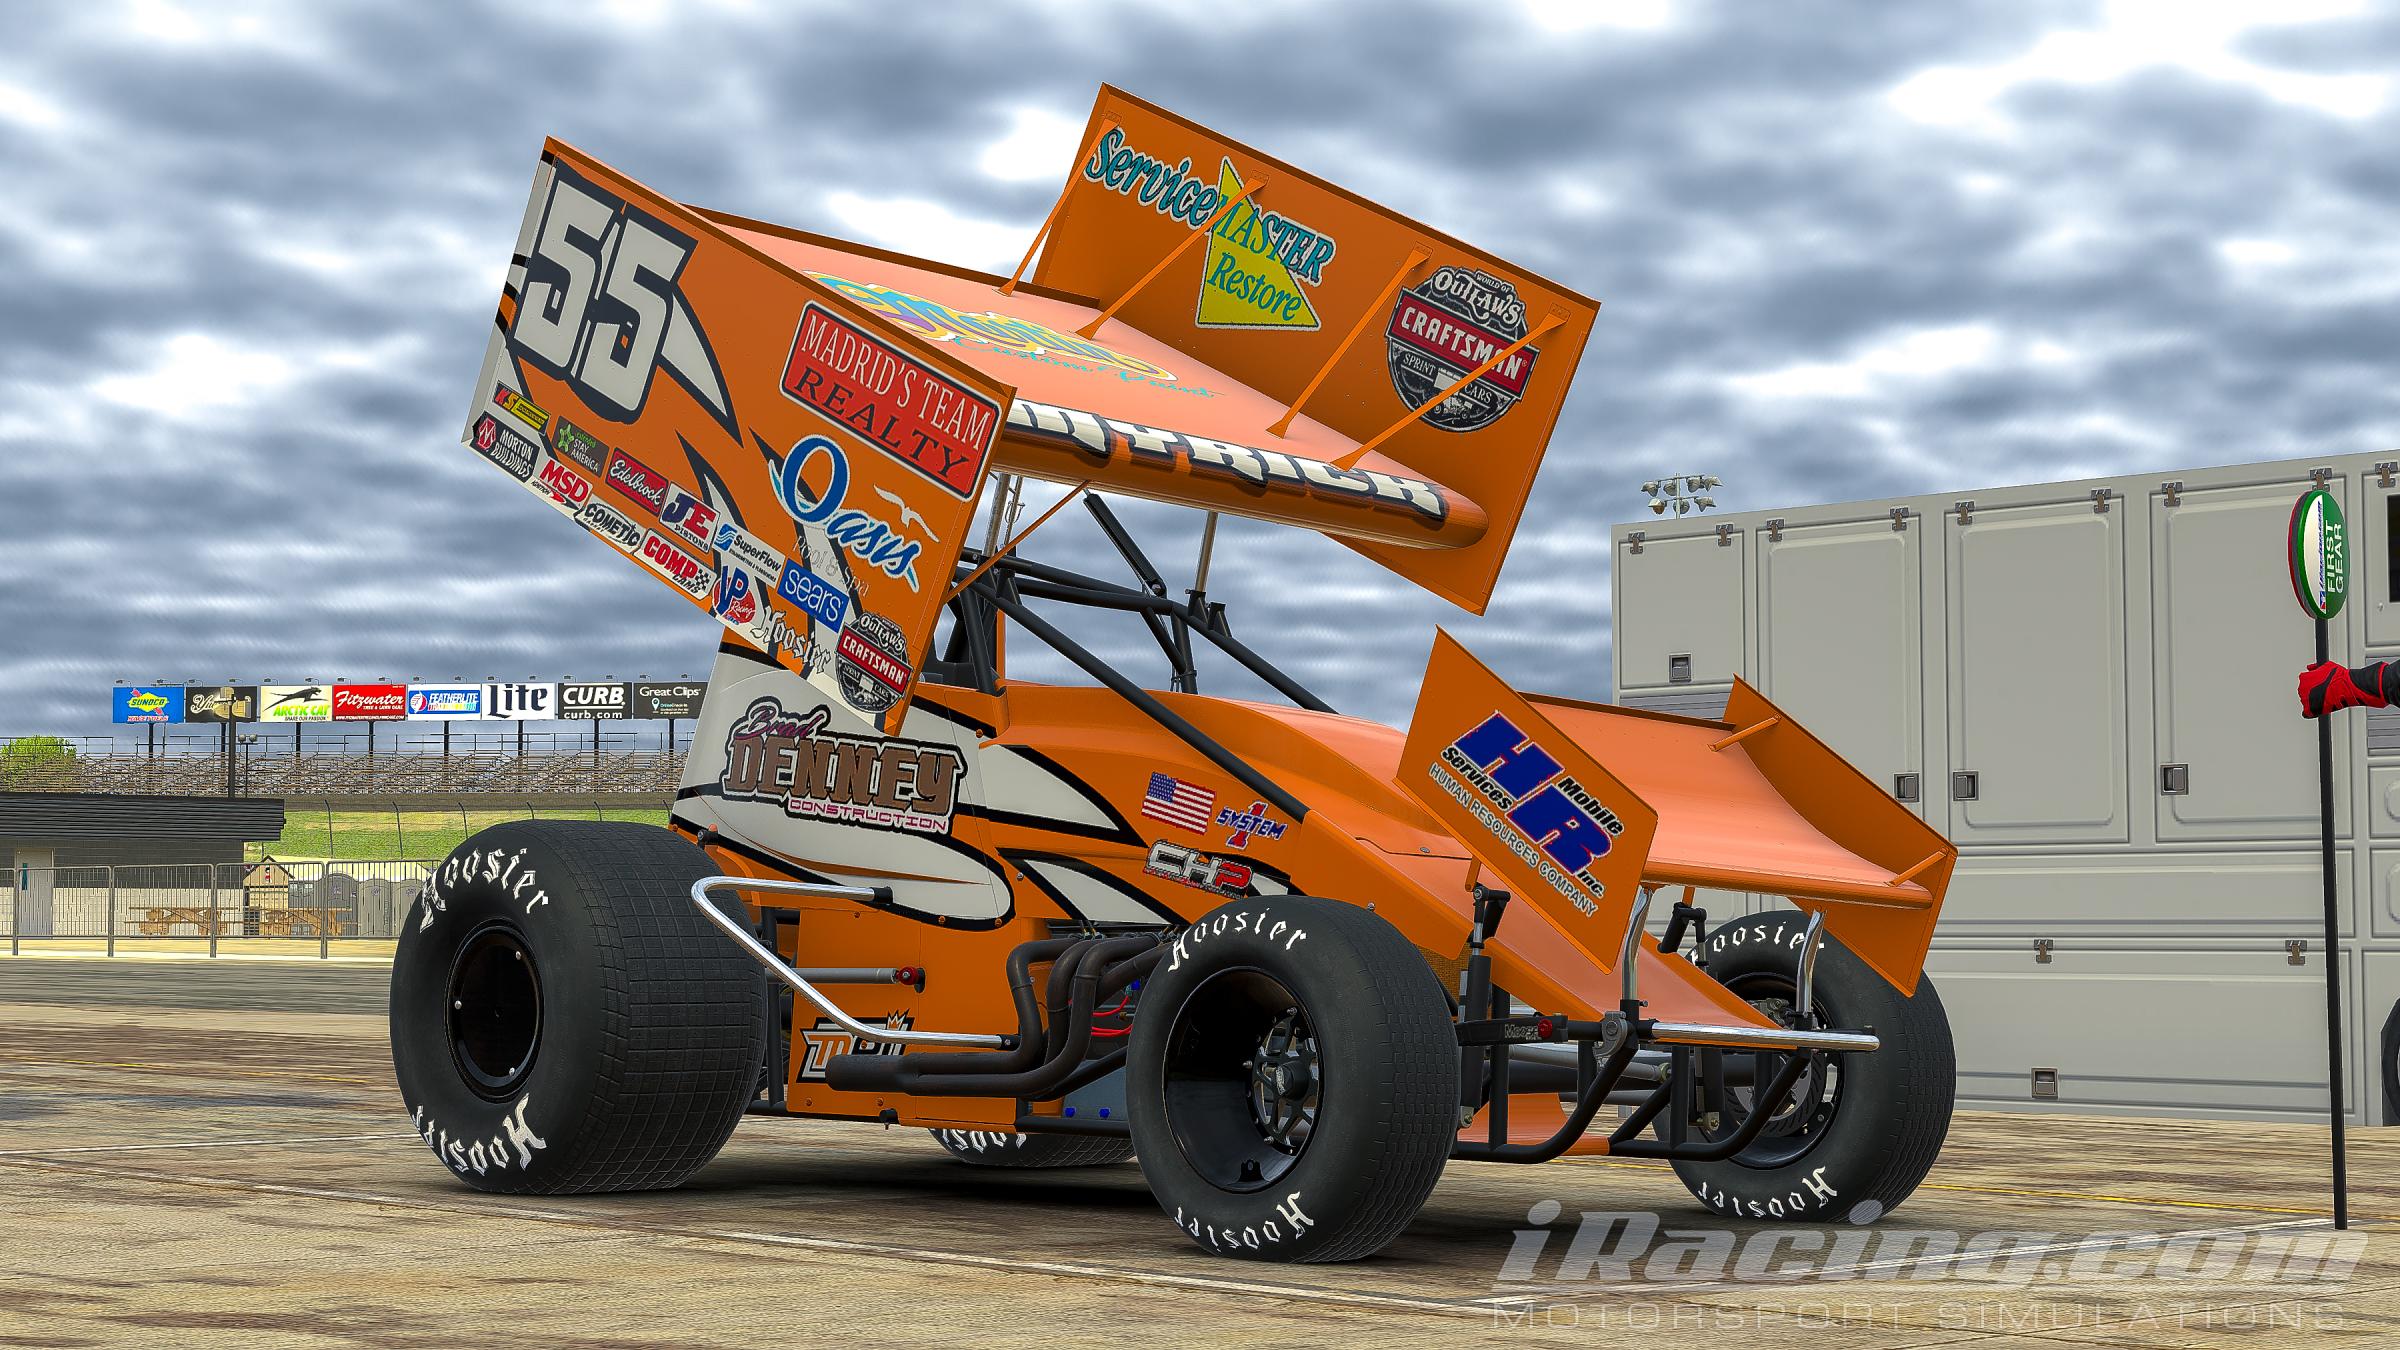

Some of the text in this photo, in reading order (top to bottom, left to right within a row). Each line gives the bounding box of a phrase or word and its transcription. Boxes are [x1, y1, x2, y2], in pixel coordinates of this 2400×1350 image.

[511, 177, 689, 413] 55
[1208, 252, 1303, 321] Restore
[1476, 273, 1511, 293] WORLD OF
[801, 314, 991, 451] MADRID'S TEAM
[1403, 354, 1436, 376] SPRINT
[1464, 384, 1492, 404] CARS
[793, 366, 970, 478] REALTY
[489, 442, 533, 479] BUILDINGS
[499, 428, 534, 462] MORTON
[570, 450, 600, 473] AMERICA
[573, 438, 590, 453] STAY
[530, 480, 551, 496] IGNITION
[539, 458, 590, 504] MSD
[609, 458, 666, 507] Edelbrock
[584, 503, 642, 547] COMETIC
[661, 492, 717, 541] JE
[776, 436, 922, 582] Oasis
[643, 535, 700, 579] COMP
[674, 524, 710, 552] PISTONS
[732, 534, 782, 573] SuperFlow
[2325, 519, 2336, 593] FIRST
[2333, 523, 2344, 594] GEAR
[672, 573, 701, 595] CAMS
[714, 564, 750, 617] VP
[784, 568, 840, 622] sears
[750, 606, 832, 674] Hoosier
[842, 635, 905, 686] CRAFTSMAN
[130, 697, 166, 707] SUNOCO
[273, 704, 329, 717] ARCTIC CAT
[336, 690, 404, 709] Fitzwater
[429, 692, 479, 704] FEATHERLITE
[487, 683, 548, 719] Lite
[563, 710, 623, 720] curb.com
[639, 686, 701, 701] Great Clips
[734, 704, 825, 741] Brad
[724, 733, 958, 817] DENNEY
[1440, 745, 1516, 814] Services
[789, 799, 947, 831] CONSTRUCTION
[1215, 807, 1288, 841] SYSTEM
[1556, 775, 1625, 839] Mobile
[1429, 762, 1599, 919] HUMAN RESOURCES COMPANY
[1577, 868, 1604, 899] Inc.
[1167, 907, 1308, 973] Hoosier
[1691, 920, 1825, 966] oosie
[1698, 1165, 1838, 1218] Hoosier
[1174, 1191, 1315, 1252] Hoosier
